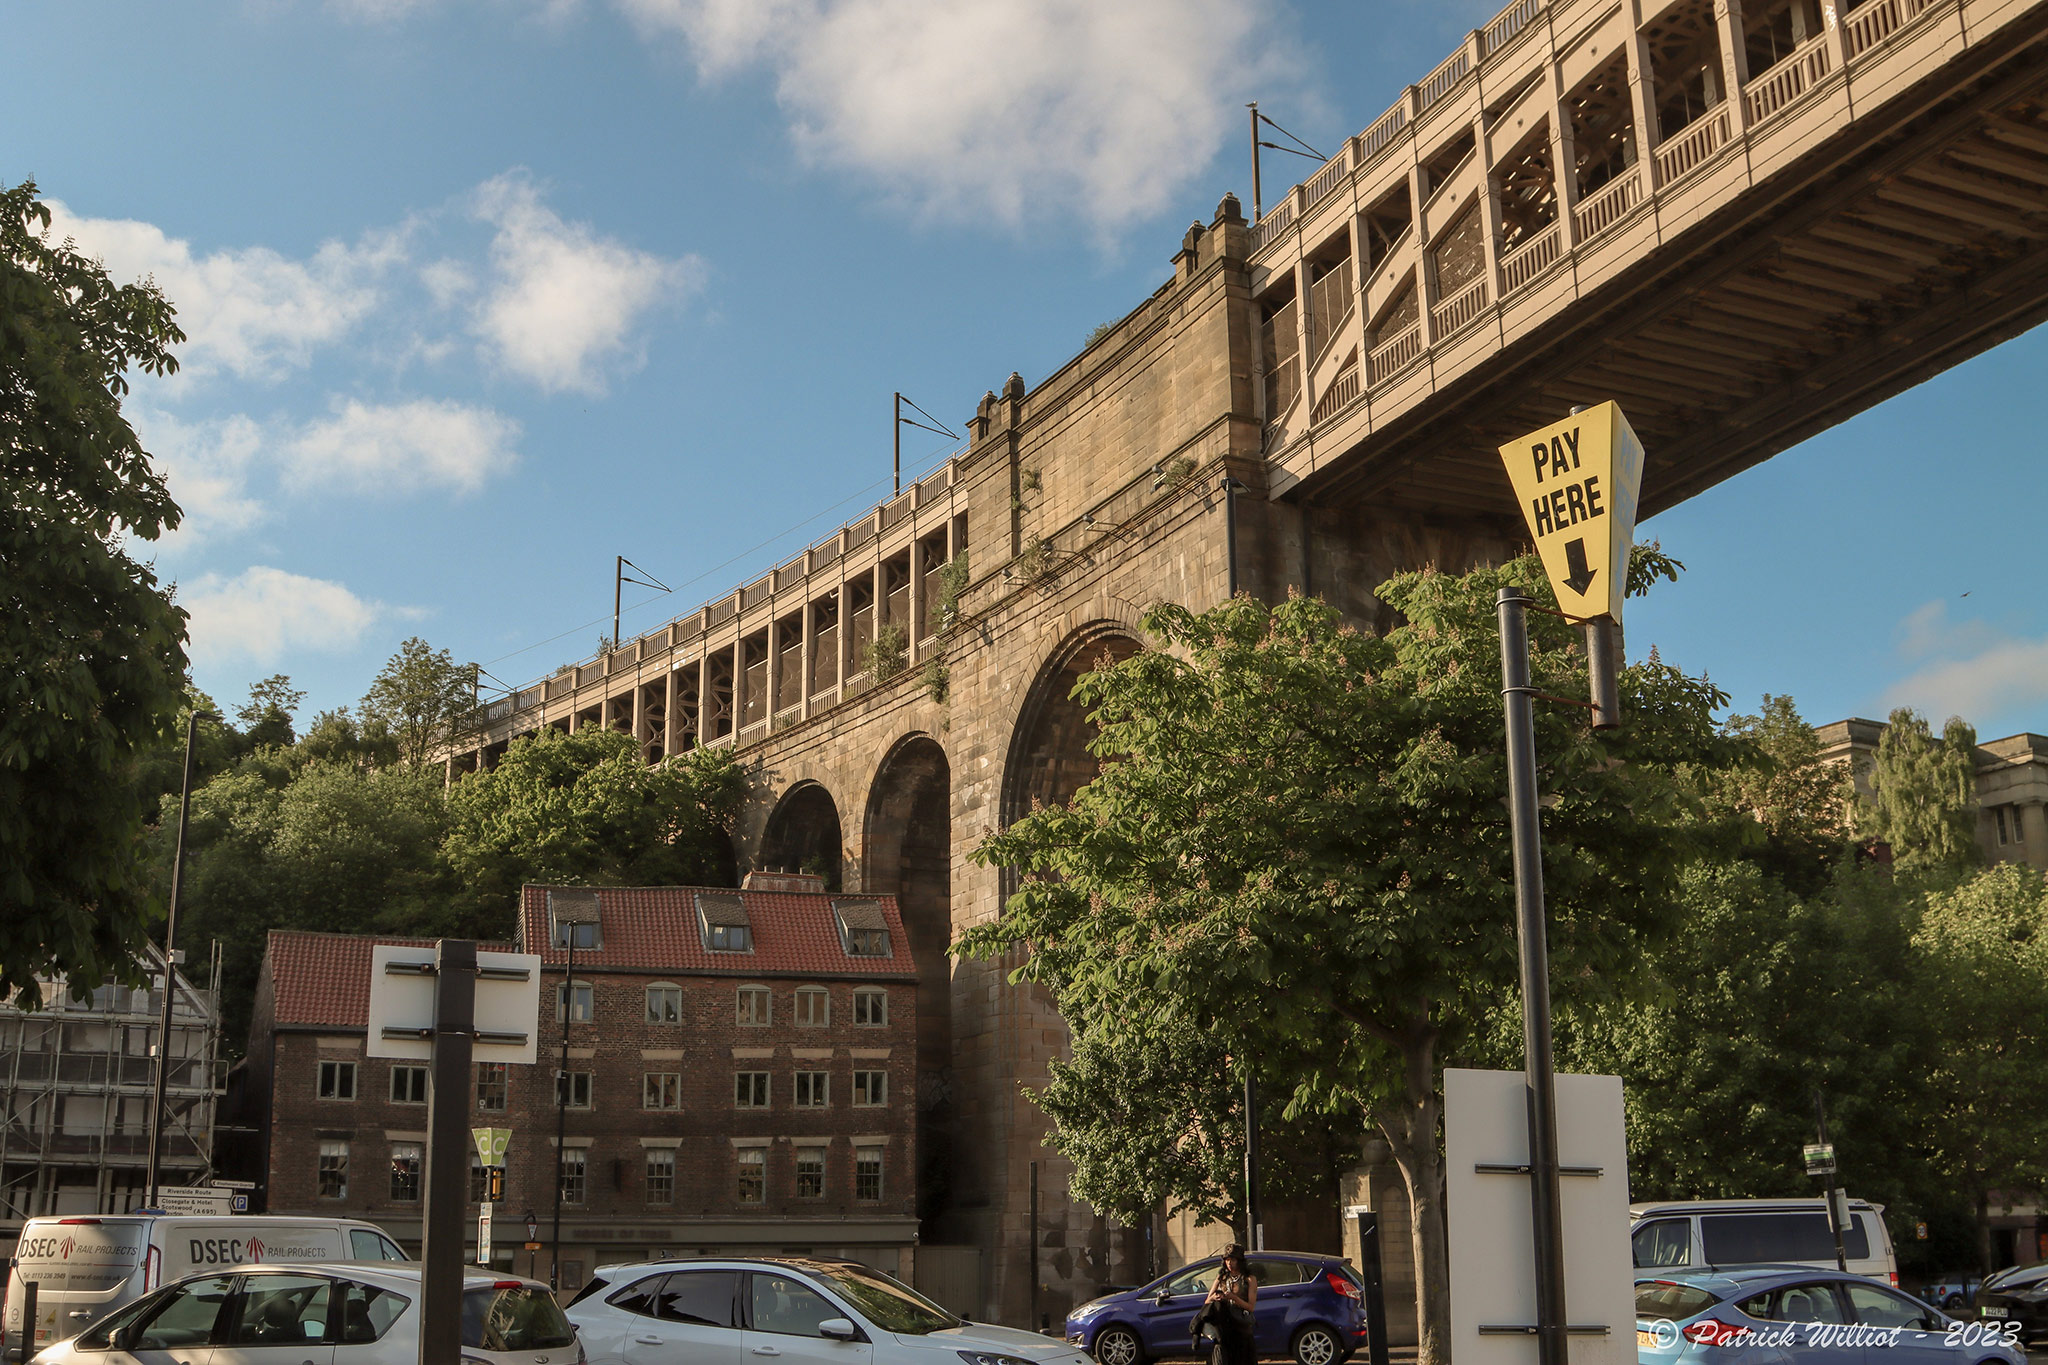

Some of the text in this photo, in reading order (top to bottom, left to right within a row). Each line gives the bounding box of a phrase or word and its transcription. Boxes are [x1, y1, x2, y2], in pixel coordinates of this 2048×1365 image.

[1531, 426, 1581, 484] PAY
[1532, 475, 1605, 538] HERE
[162, 1198, 190, 1206] Closegate
[167, 1188, 194, 1196] Riverside
[20, 1238, 138, 1258] DSEC RAIL PROJECTS
[190, 1239, 326, 1264] DSEC RAIL PROJECTS
